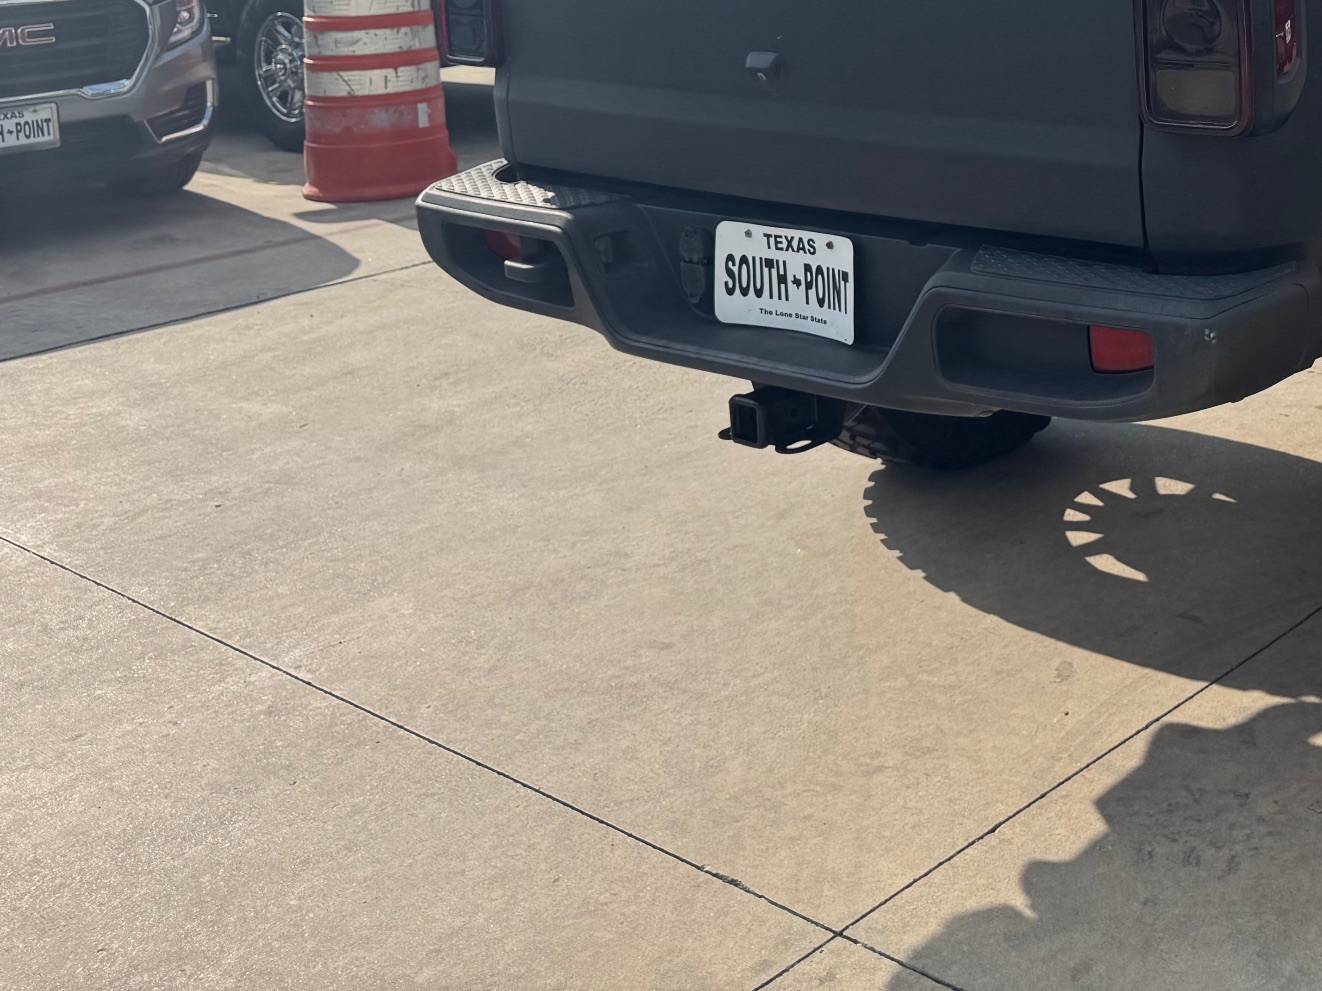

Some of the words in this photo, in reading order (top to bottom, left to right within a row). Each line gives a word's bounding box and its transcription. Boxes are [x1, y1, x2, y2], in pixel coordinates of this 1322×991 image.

[15, 118, 52, 141] POINT
[763, 232, 817, 256] TEXAS
[724, 253, 790, 302] SOUTH
[803, 262, 850, 315] POINT
[759, 307, 774, 316] The
[775, 309, 793, 318] Lone
[794, 312, 809, 321] Star
[810, 315, 828, 325] State
